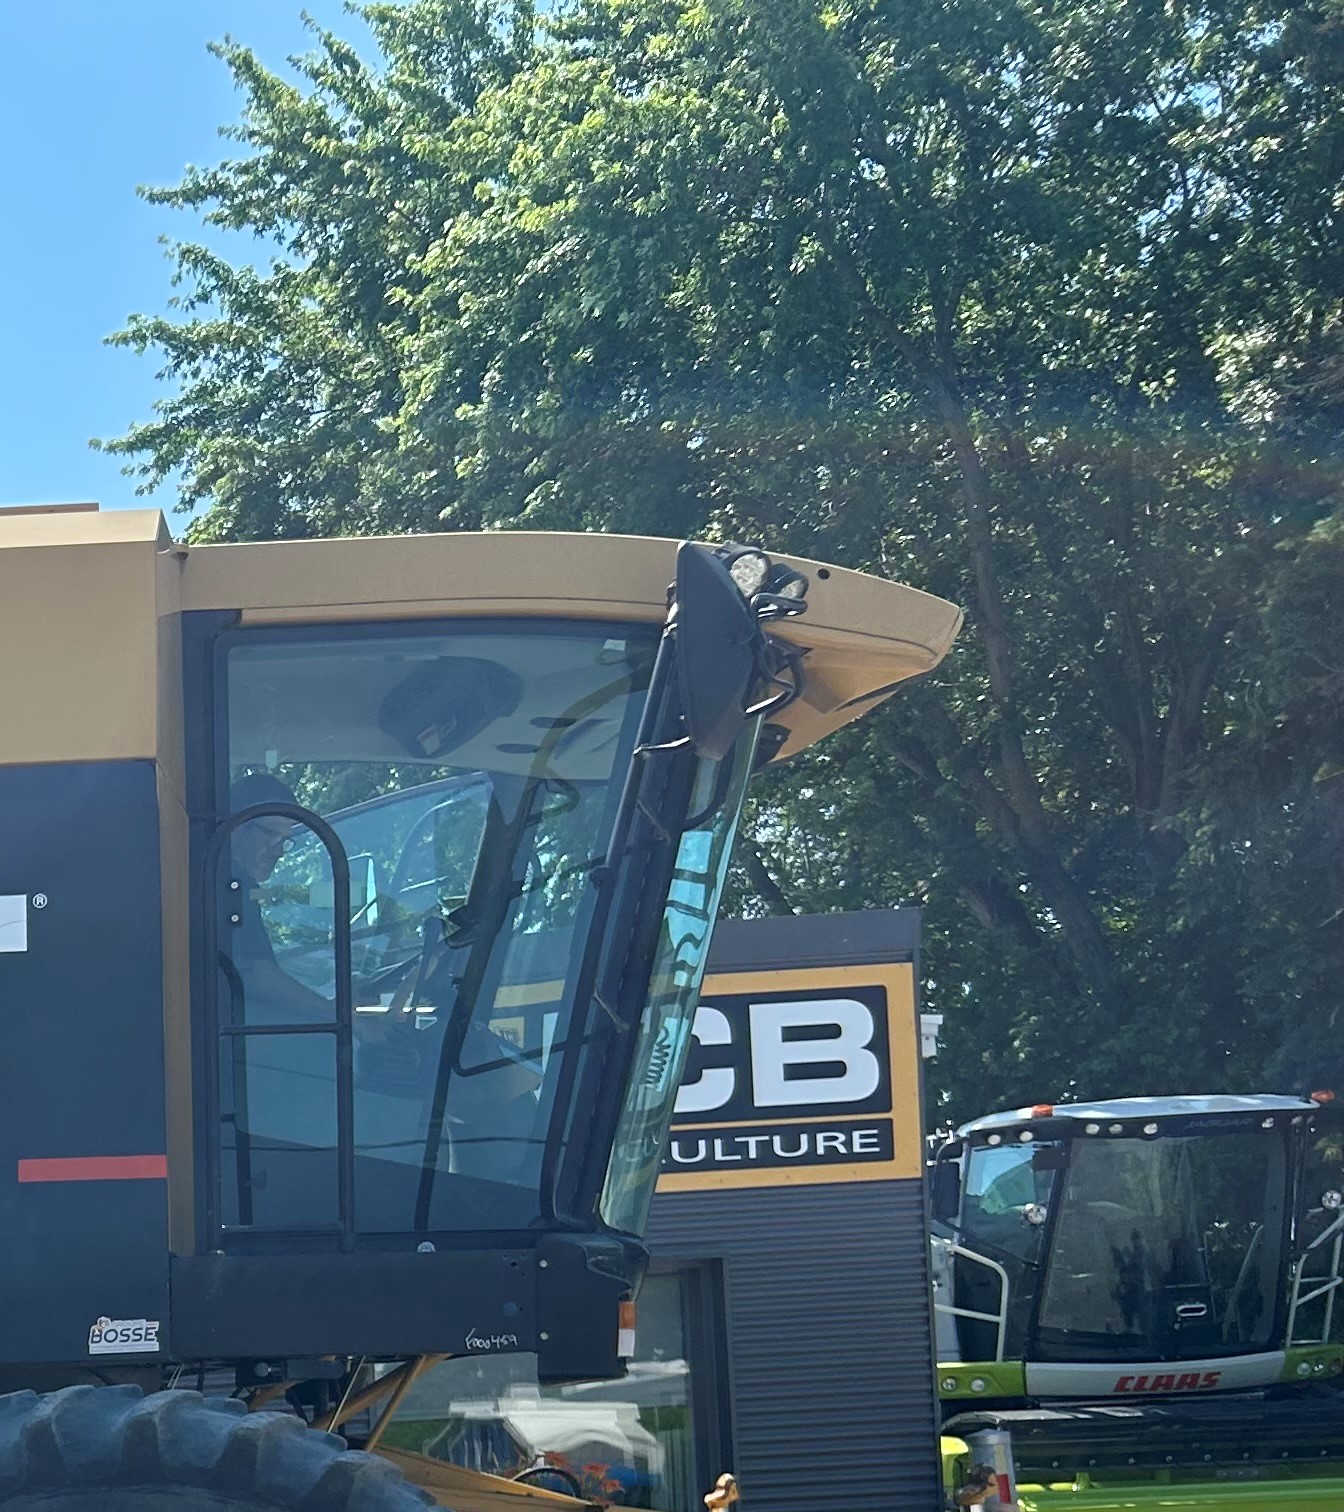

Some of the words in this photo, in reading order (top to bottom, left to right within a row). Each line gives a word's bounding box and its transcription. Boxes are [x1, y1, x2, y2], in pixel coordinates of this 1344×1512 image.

[662, 1128, 881, 1164] ULTURE
[91, 1326, 157, 1344] BOSSE
[1113, 1371, 1221, 1392] CLAAS
